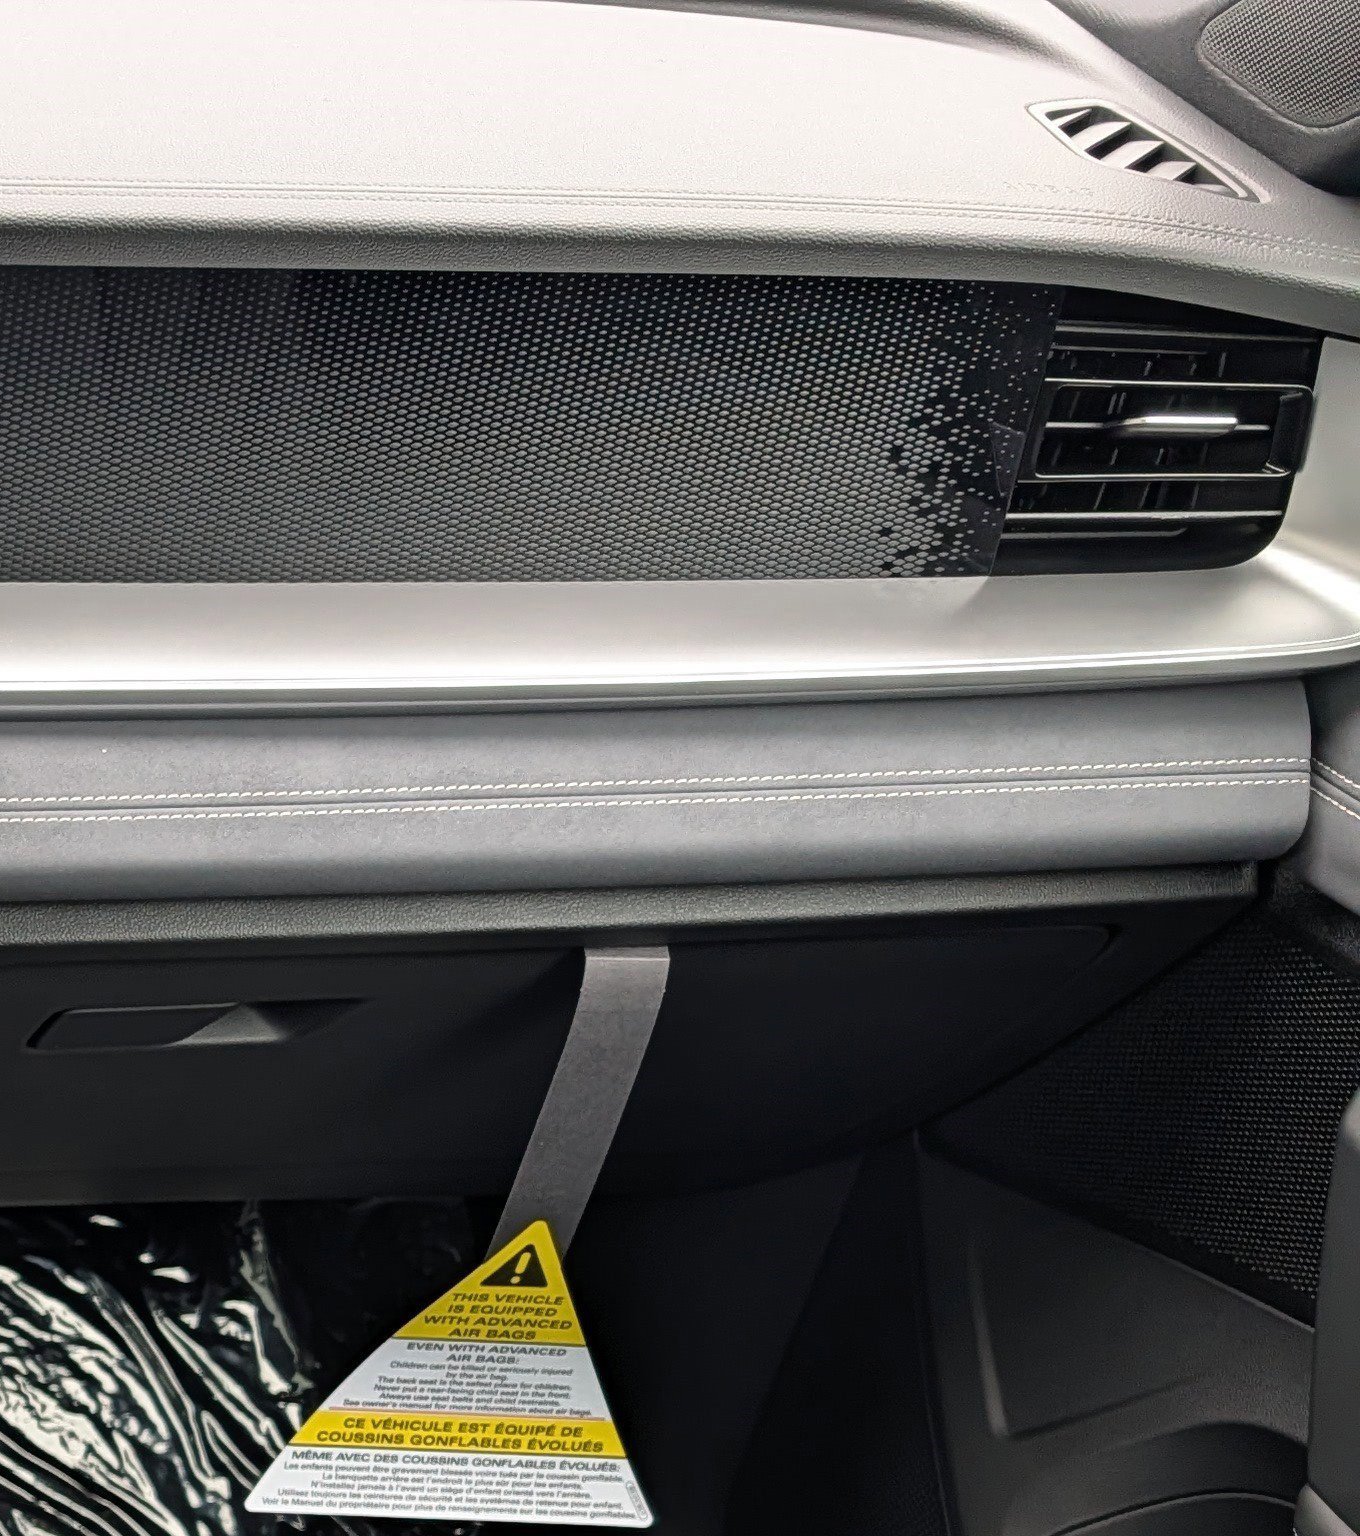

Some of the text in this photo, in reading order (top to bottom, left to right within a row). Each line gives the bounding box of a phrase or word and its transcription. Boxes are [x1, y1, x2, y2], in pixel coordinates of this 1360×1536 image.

[453, 1293, 564, 1306] THIS VEHICLE
[448, 1304, 558, 1317] IS EQUIPPED
[424, 1316, 573, 1330] WITH ADVANCED
[448, 1328, 537, 1340] AIR BAGS
[407, 1342, 567, 1356] EVEN WITH ADVANCED
[445, 1354, 471, 1362] AIR
[343, 1417, 584, 1438] CE VÉHICULE EST ÉQUIPÉ DE
[317, 1430, 604, 1452] COUSSINS GONFLABLES ÉVOLUÉS
[291, 1450, 333, 1461] MÊME
[335, 1453, 371, 1462] AVEC
[373, 1453, 399, 1463] DES
[402, 1454, 469, 1466] COUSSINS
[471, 1457, 556, 1470] GONFLABLES
